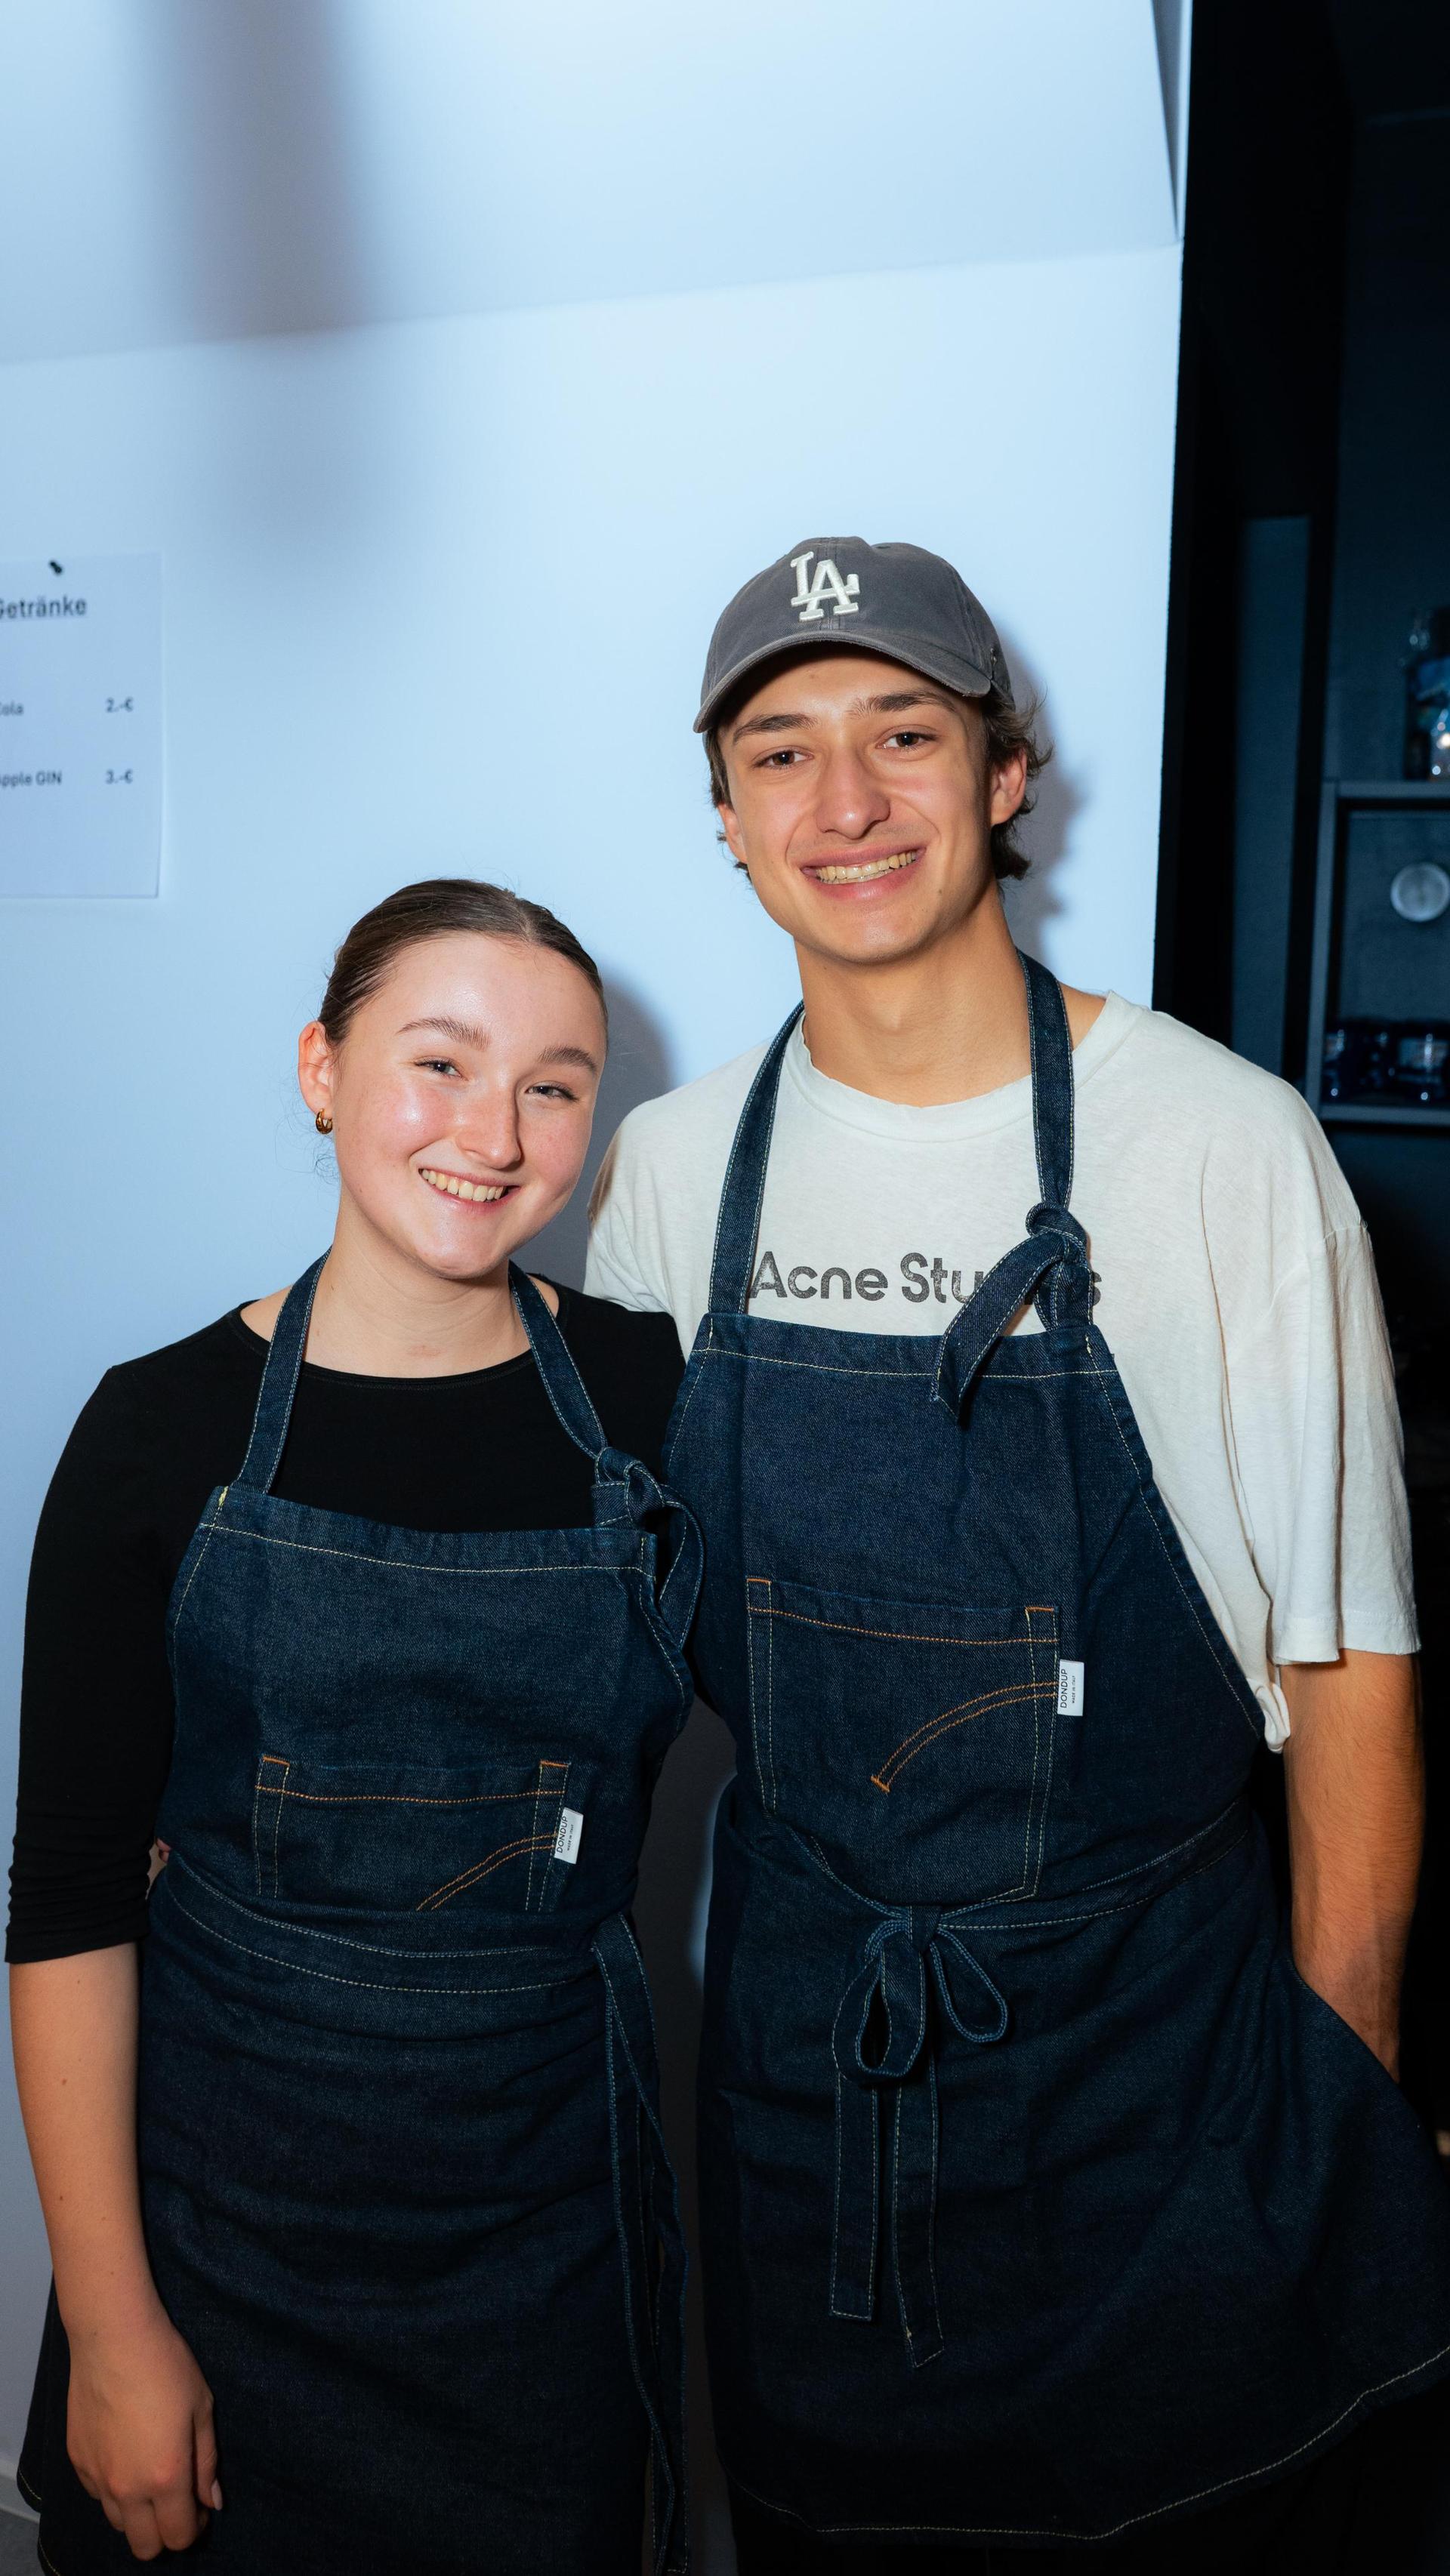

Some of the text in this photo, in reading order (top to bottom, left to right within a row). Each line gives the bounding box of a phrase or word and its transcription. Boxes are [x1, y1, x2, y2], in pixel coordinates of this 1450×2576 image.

[791, 551, 860, 622] LA
[0, 700, 25, 716] ola
[0, 772, 32, 790] pple
[748, 1251, 888, 1301] Acne
[1060, 1669, 1068, 1709] DONDUP
[556, 1816, 568, 1853] DONDUP
